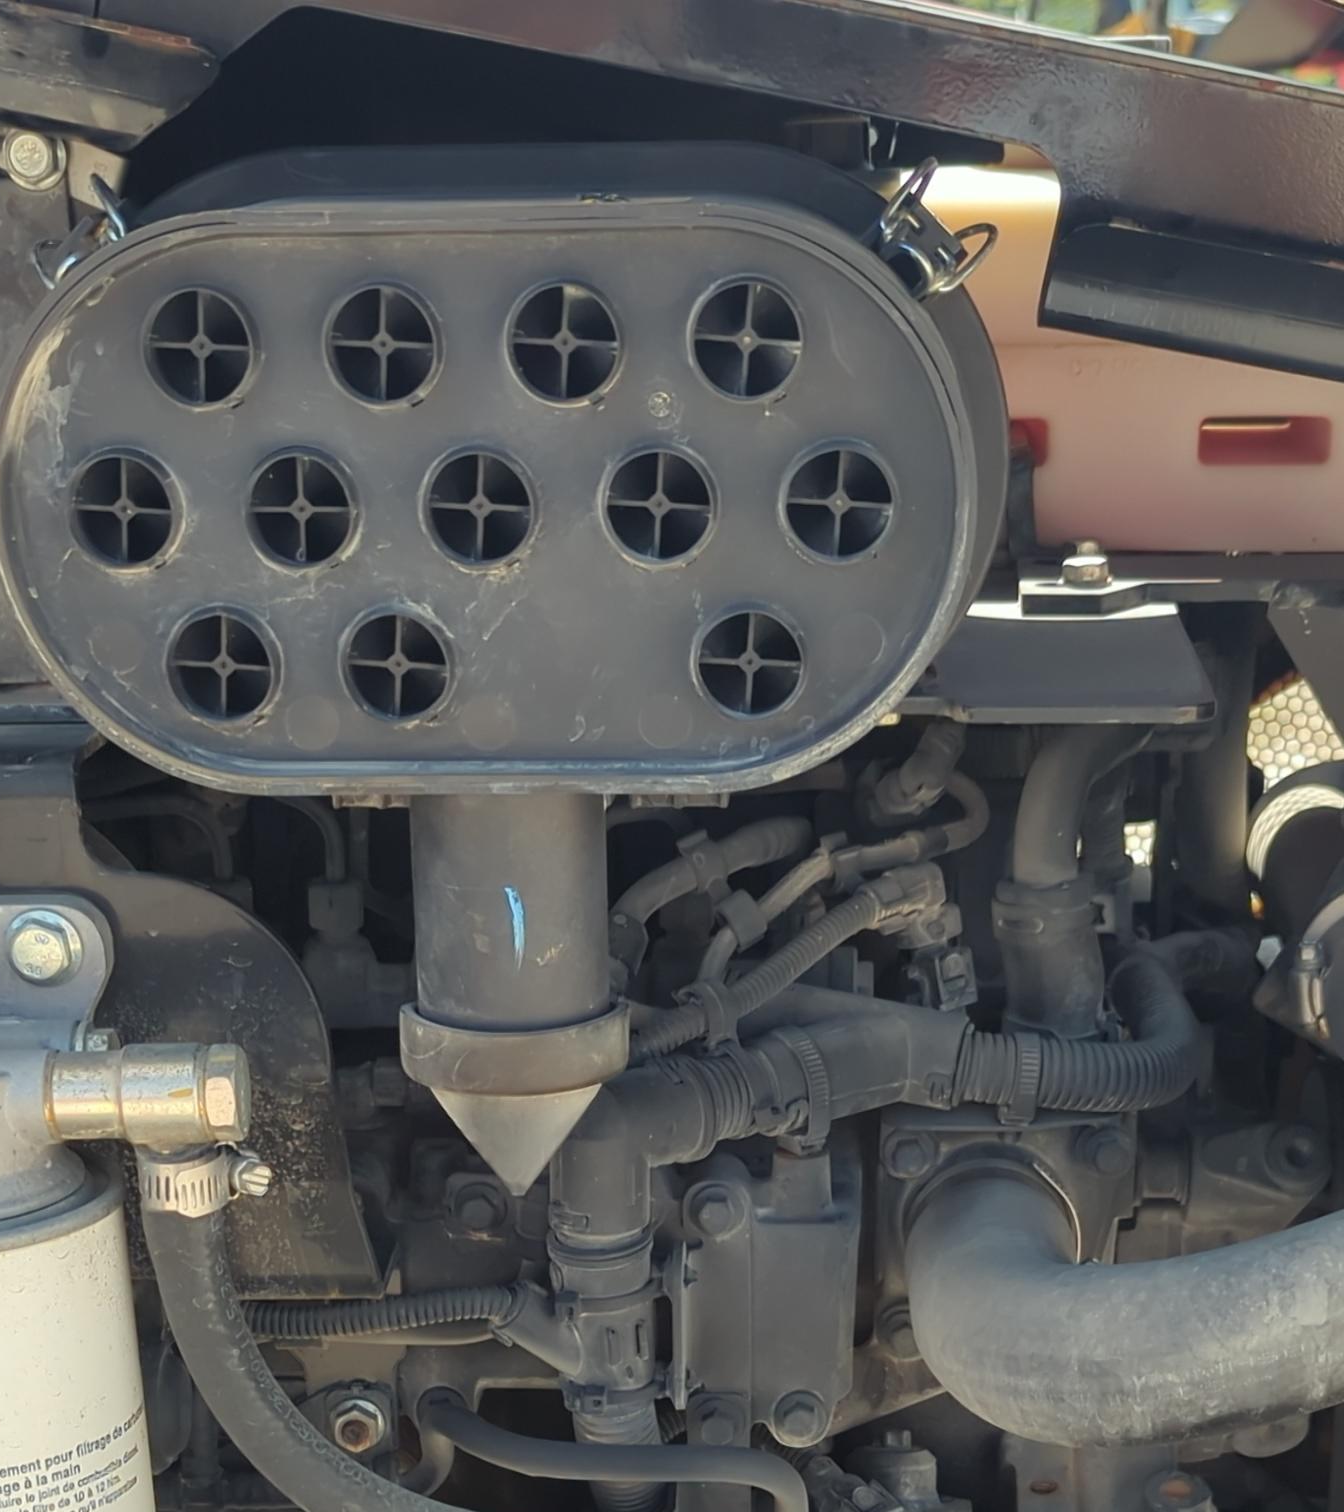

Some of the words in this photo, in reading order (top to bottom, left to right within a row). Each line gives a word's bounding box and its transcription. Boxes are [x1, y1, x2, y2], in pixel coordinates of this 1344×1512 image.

[44, 1449, 74, 1470] pour
[76, 1432, 112, 1459] filtrage
[112, 1425, 123, 1441] de
[24, 1476, 33, 1491] à
[36, 1474, 49, 1487] la
[51, 1463, 82, 1481] main
[26, 1492, 36, 1504] le
[38, 1487, 61, 1506] joint
[63, 1481, 75, 1493] de
[58, 1497, 71, 1509] de
